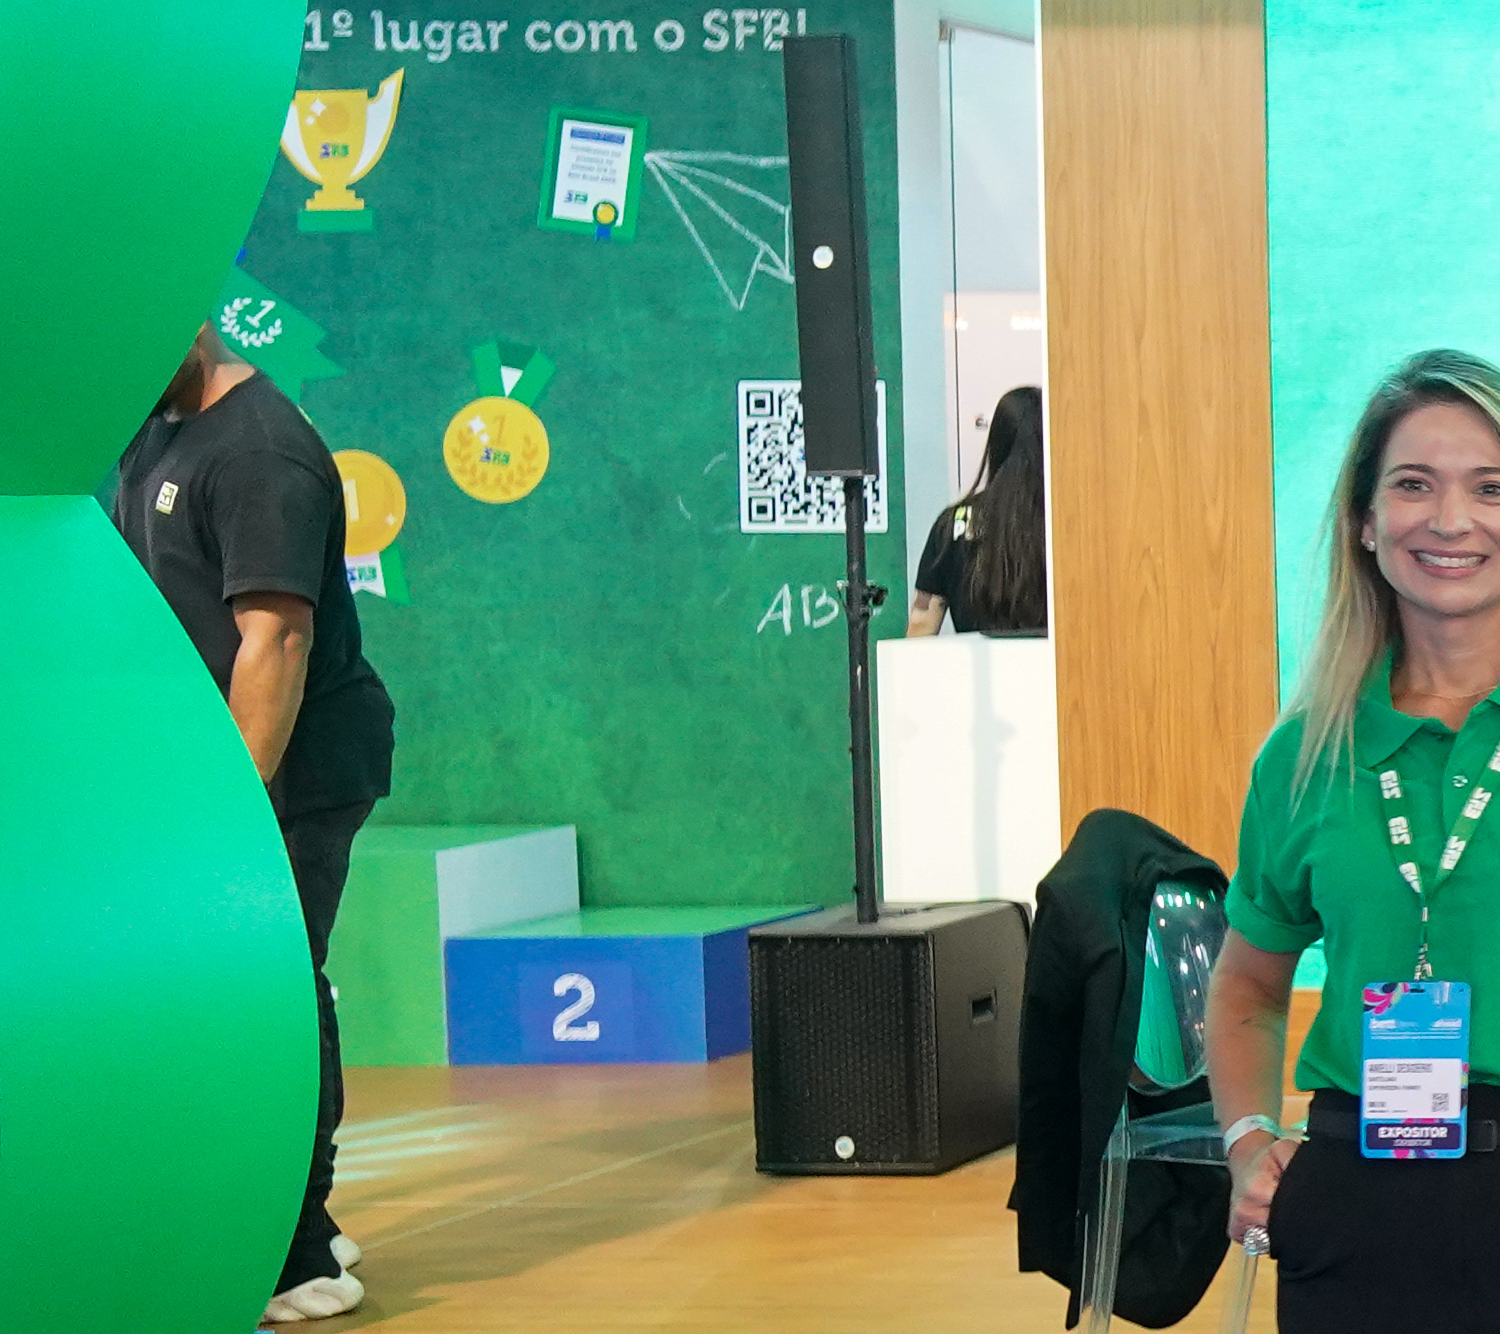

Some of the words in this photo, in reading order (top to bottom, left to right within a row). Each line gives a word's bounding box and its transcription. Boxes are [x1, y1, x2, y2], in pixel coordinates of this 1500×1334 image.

[372, 10, 509, 64] lugar
[524, 17, 637, 53] com
[654, 20, 685, 53] o
[552, 972, 600, 1041] 2
[1378, 1127, 1448, 1138] EXPOSITOR
